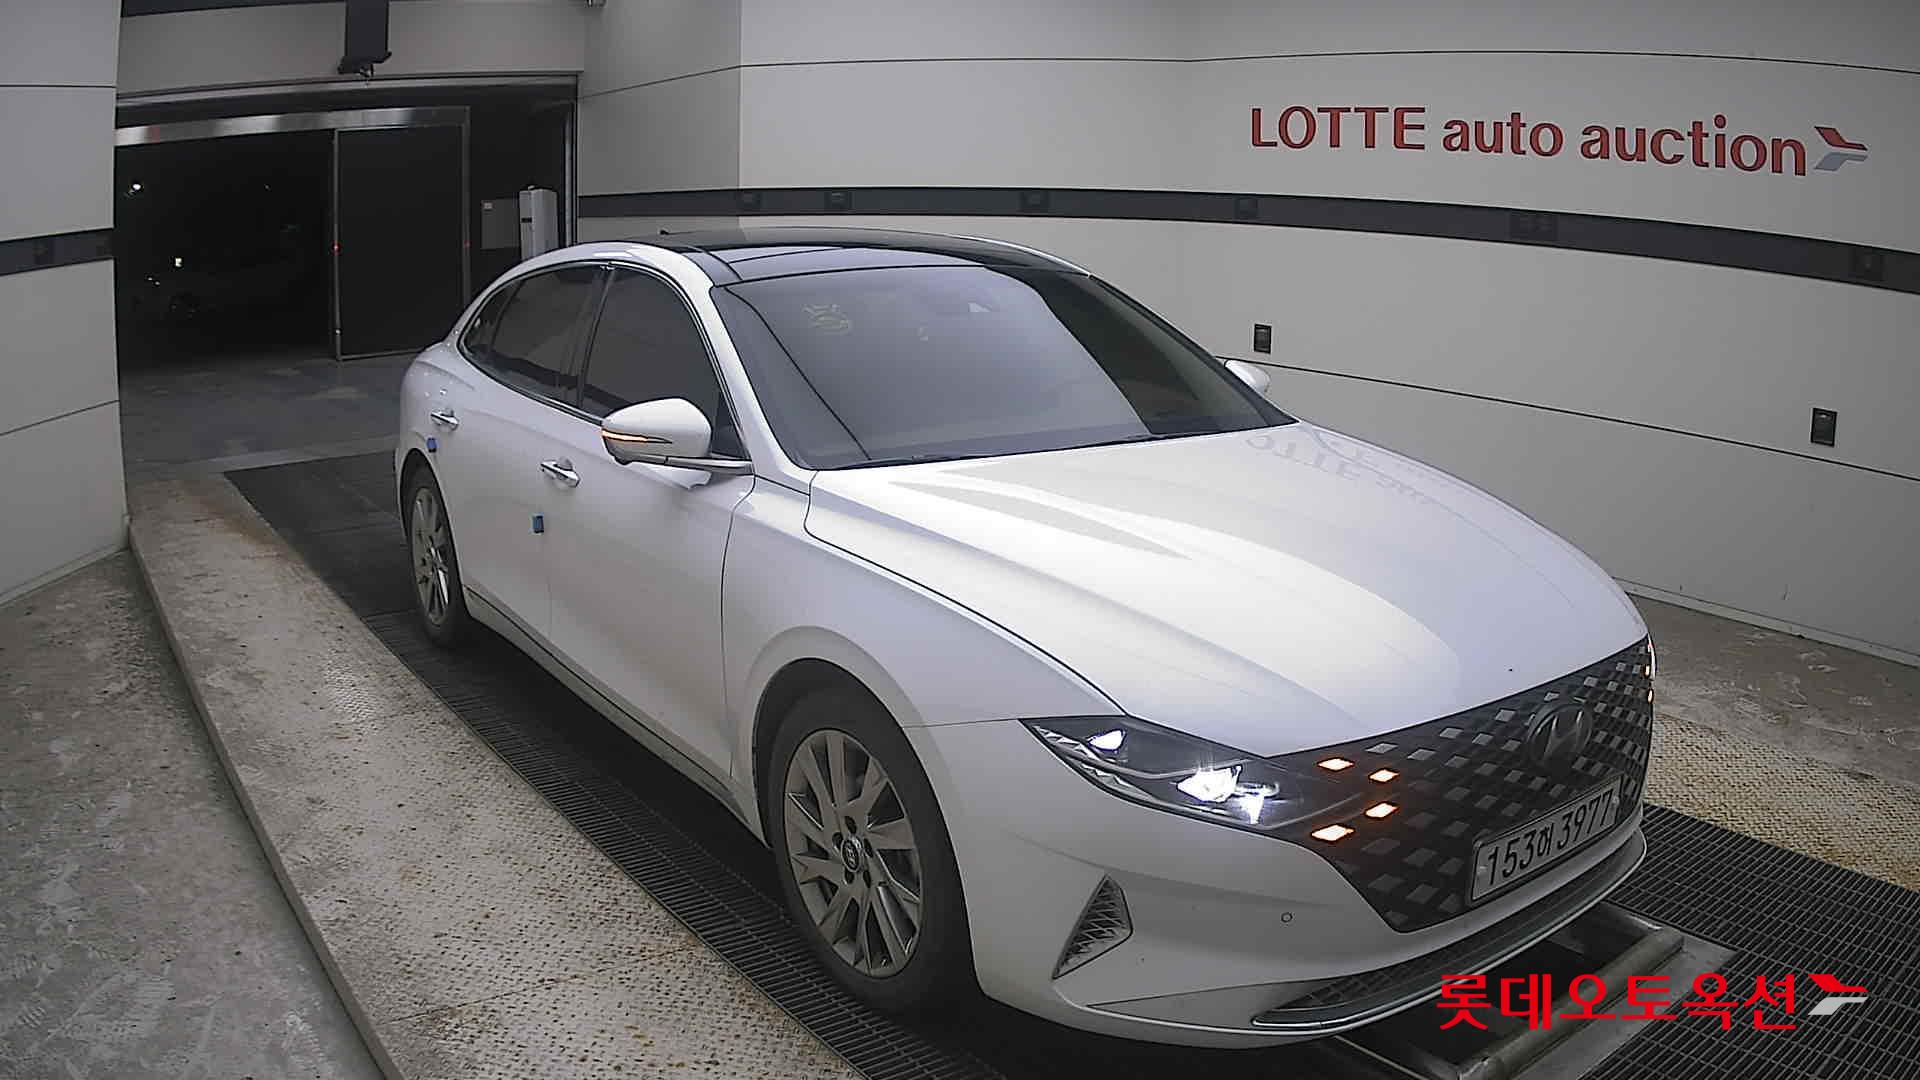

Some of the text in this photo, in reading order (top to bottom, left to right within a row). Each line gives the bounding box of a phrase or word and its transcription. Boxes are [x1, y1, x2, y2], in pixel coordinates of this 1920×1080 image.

[1251, 106, 1806, 176] LOTTE auto auction
[1557, 788, 1614, 850] 3977
